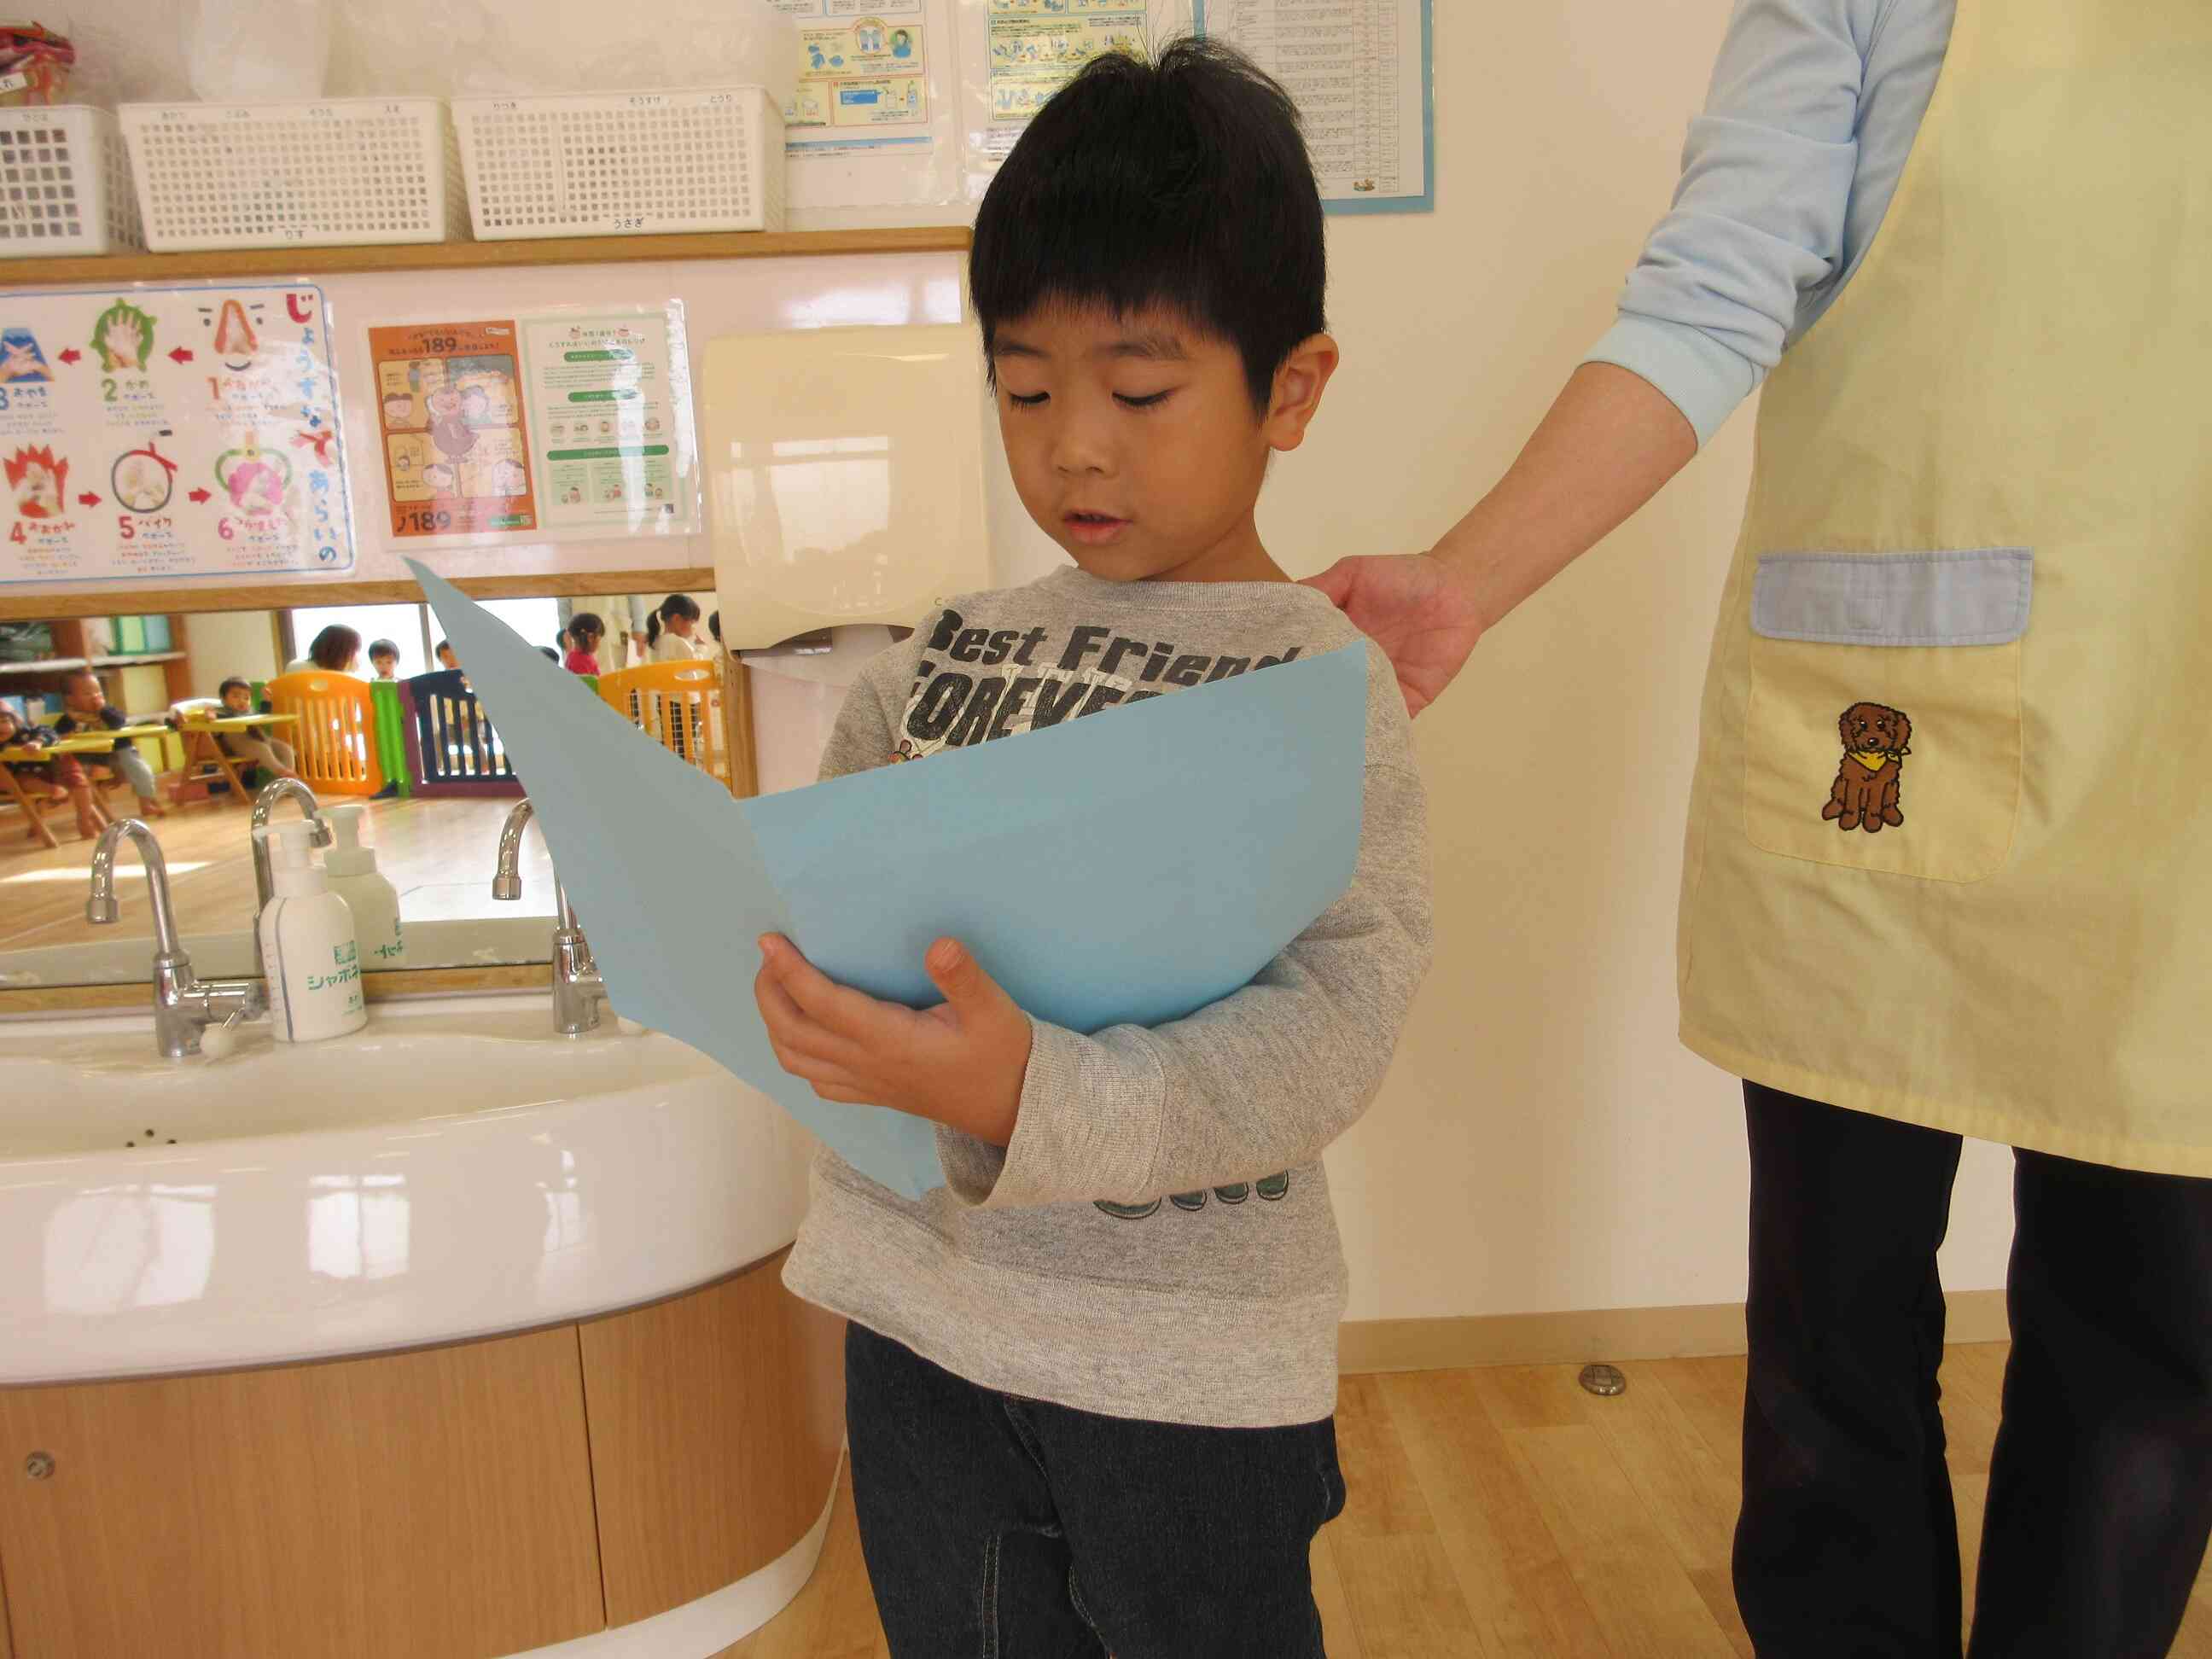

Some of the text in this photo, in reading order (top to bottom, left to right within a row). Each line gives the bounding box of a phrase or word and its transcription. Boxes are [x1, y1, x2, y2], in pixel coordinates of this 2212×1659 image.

[614, 217, 643, 230] うさぎ
[101, 378, 118, 402] 2
[9, 521, 26, 544] 4
[118, 515, 136, 540] 5
[218, 517, 235, 540] 6
